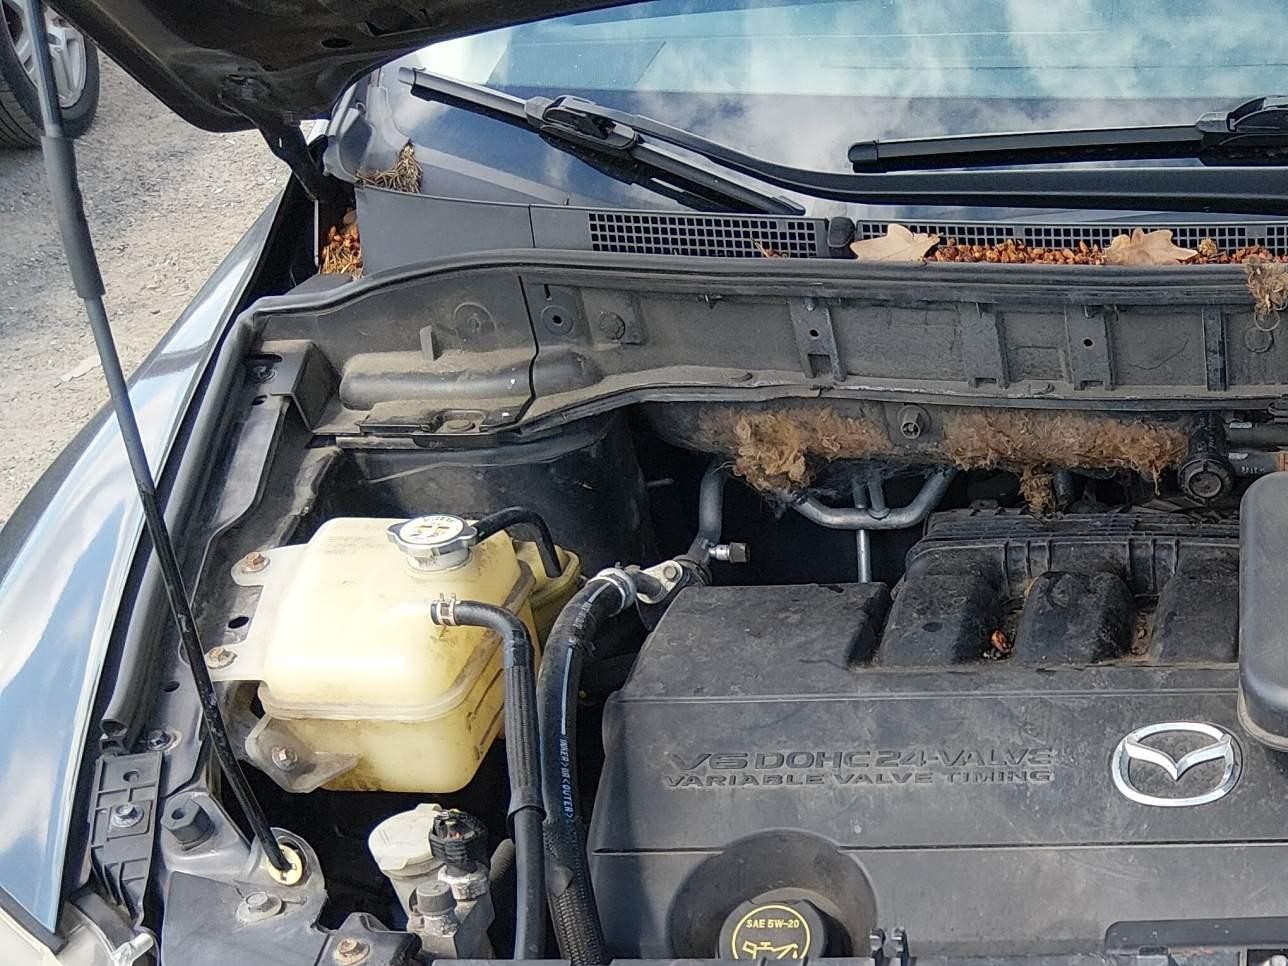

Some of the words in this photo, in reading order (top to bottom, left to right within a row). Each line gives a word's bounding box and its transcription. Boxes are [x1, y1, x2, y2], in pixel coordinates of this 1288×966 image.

[671, 752, 749, 770] V6
[754, 750, 871, 769] DOHC
[877, 747, 1053, 768] 24-VALVE
[663, 773, 825, 787] VARIABLE
[834, 772, 933, 785] VALVE
[944, 770, 1053, 784] TIMING
[746, 919, 766, 929] SAE
[767, 919, 800, 929] 5W-20
